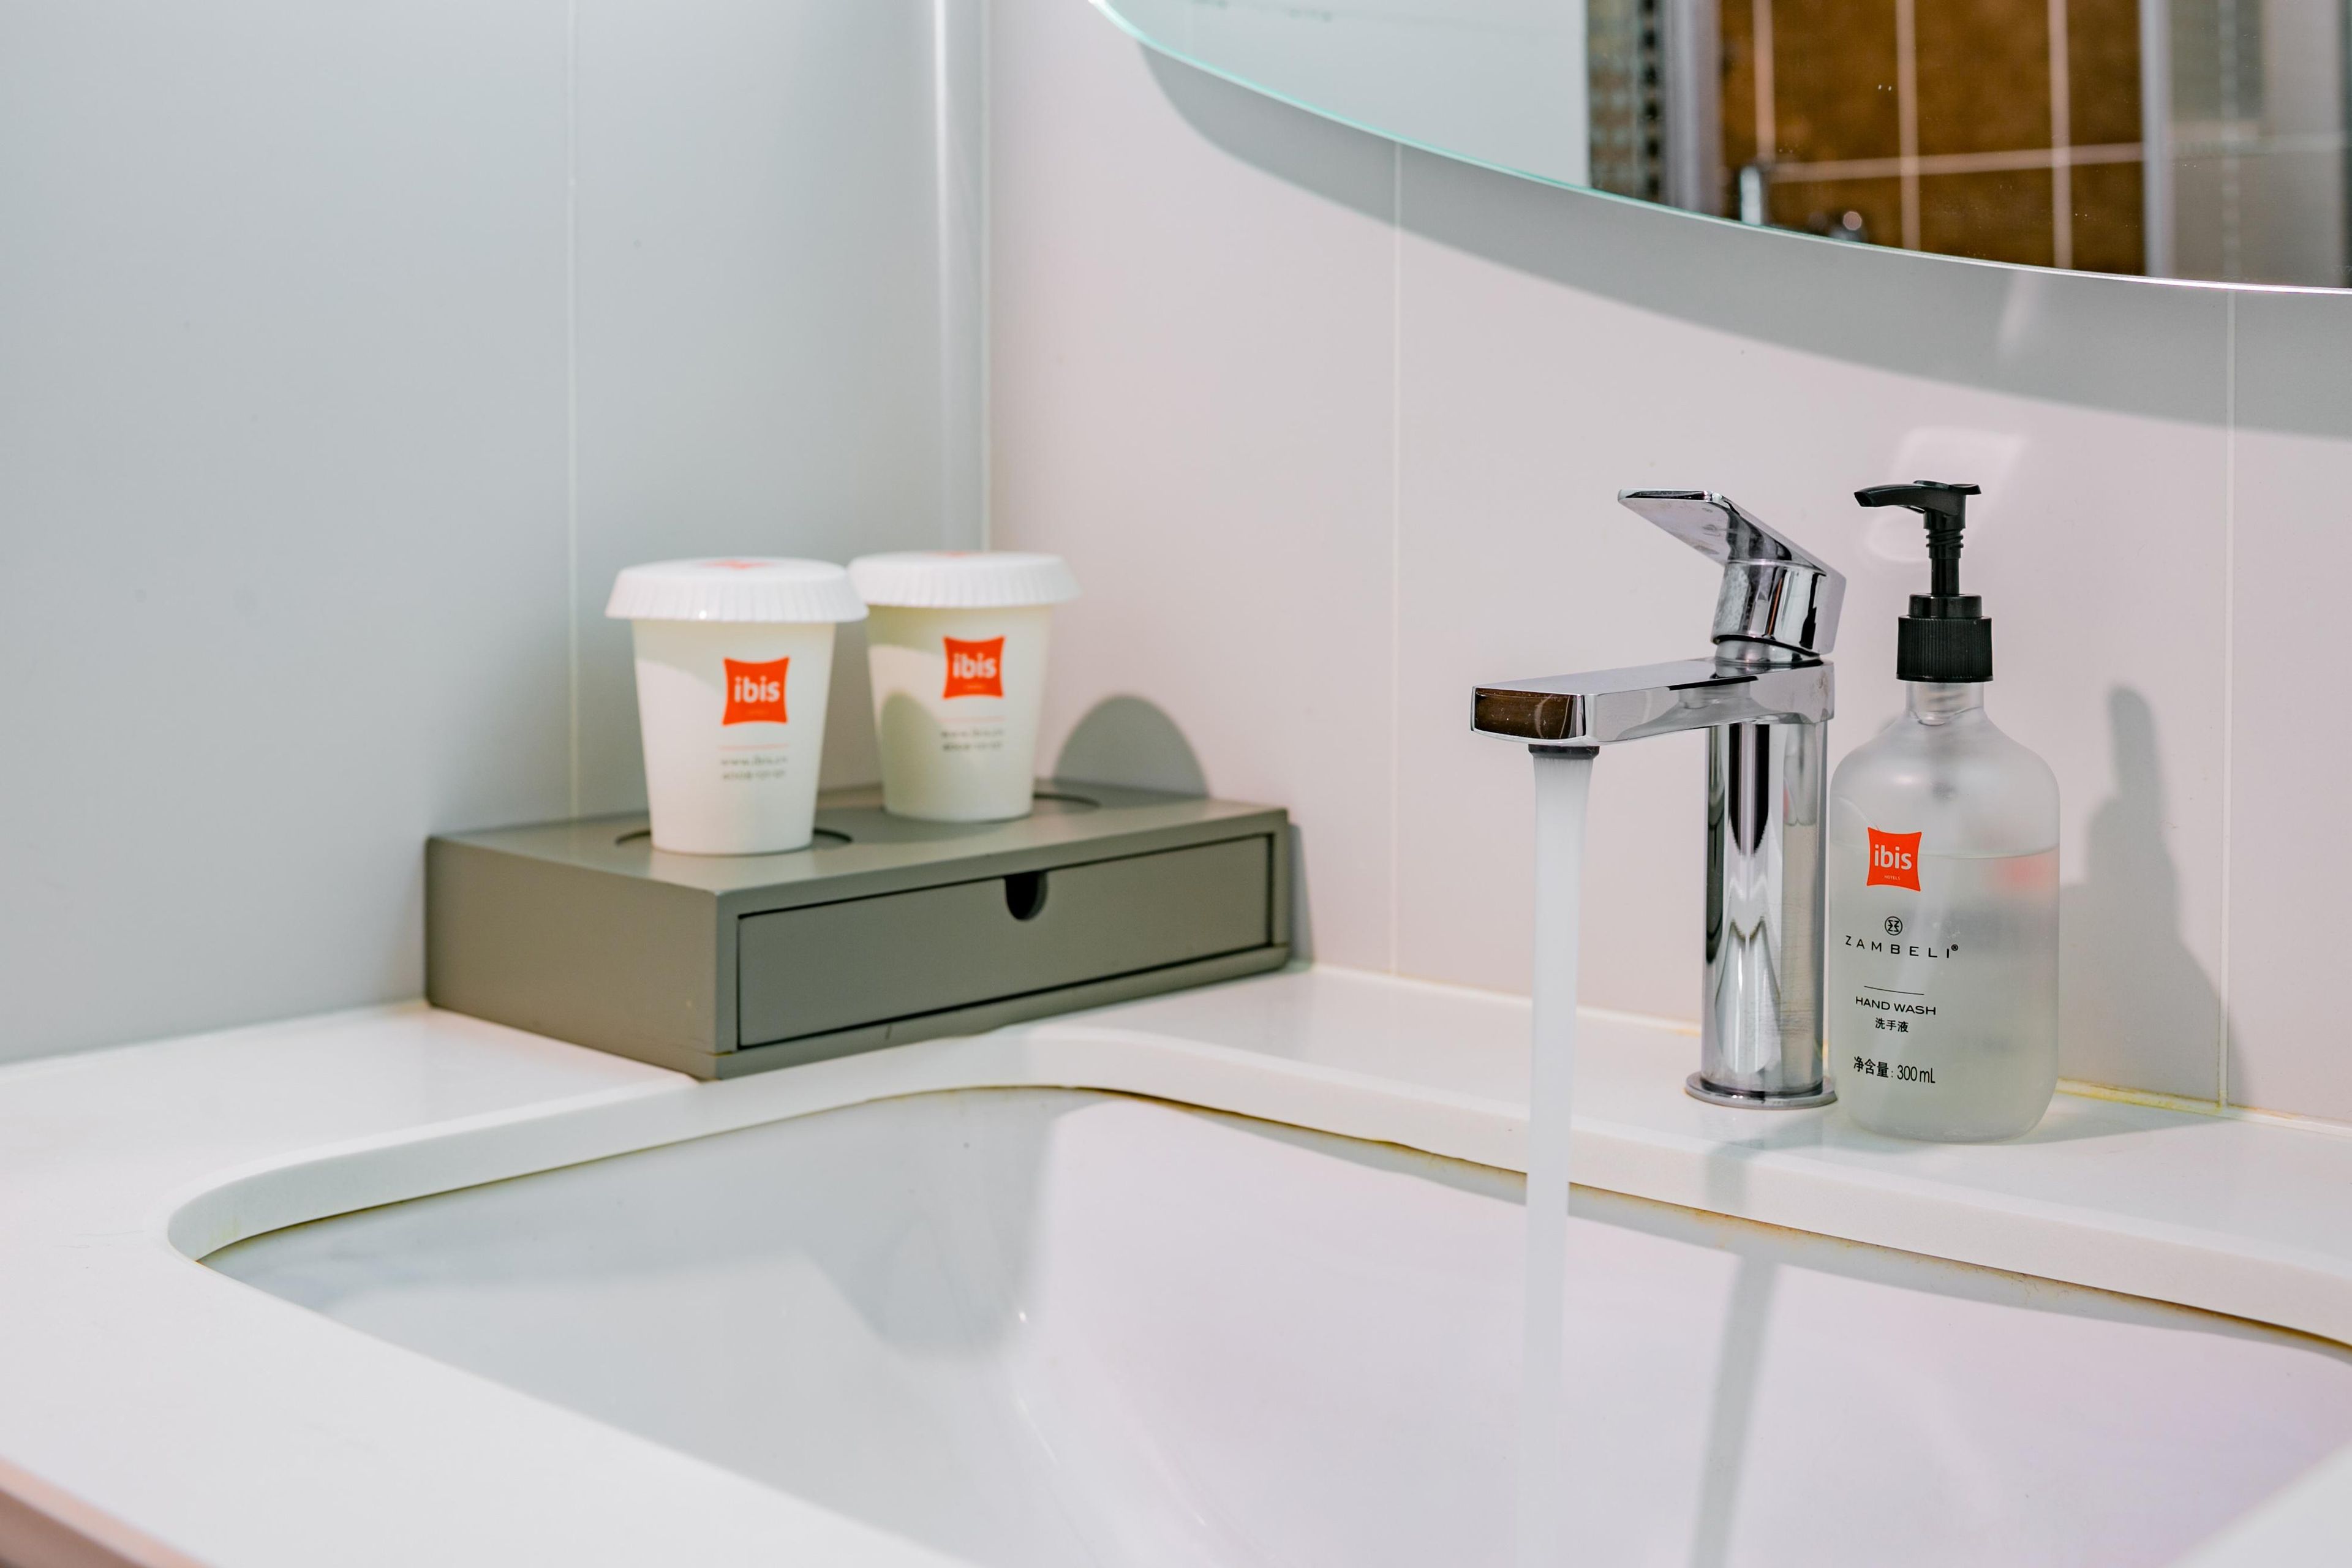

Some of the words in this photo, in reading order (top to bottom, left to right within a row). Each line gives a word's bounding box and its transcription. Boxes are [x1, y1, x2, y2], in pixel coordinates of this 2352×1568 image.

[952, 652, 997, 679] ibis
[734, 676, 781, 703] ibis
[1874, 843, 1912, 870] ibis
[1855, 996, 1890, 1010] HAND
[1893, 1003, 1936, 1016] WASH
[1875, 1017, 1909, 1033] 洗手液
